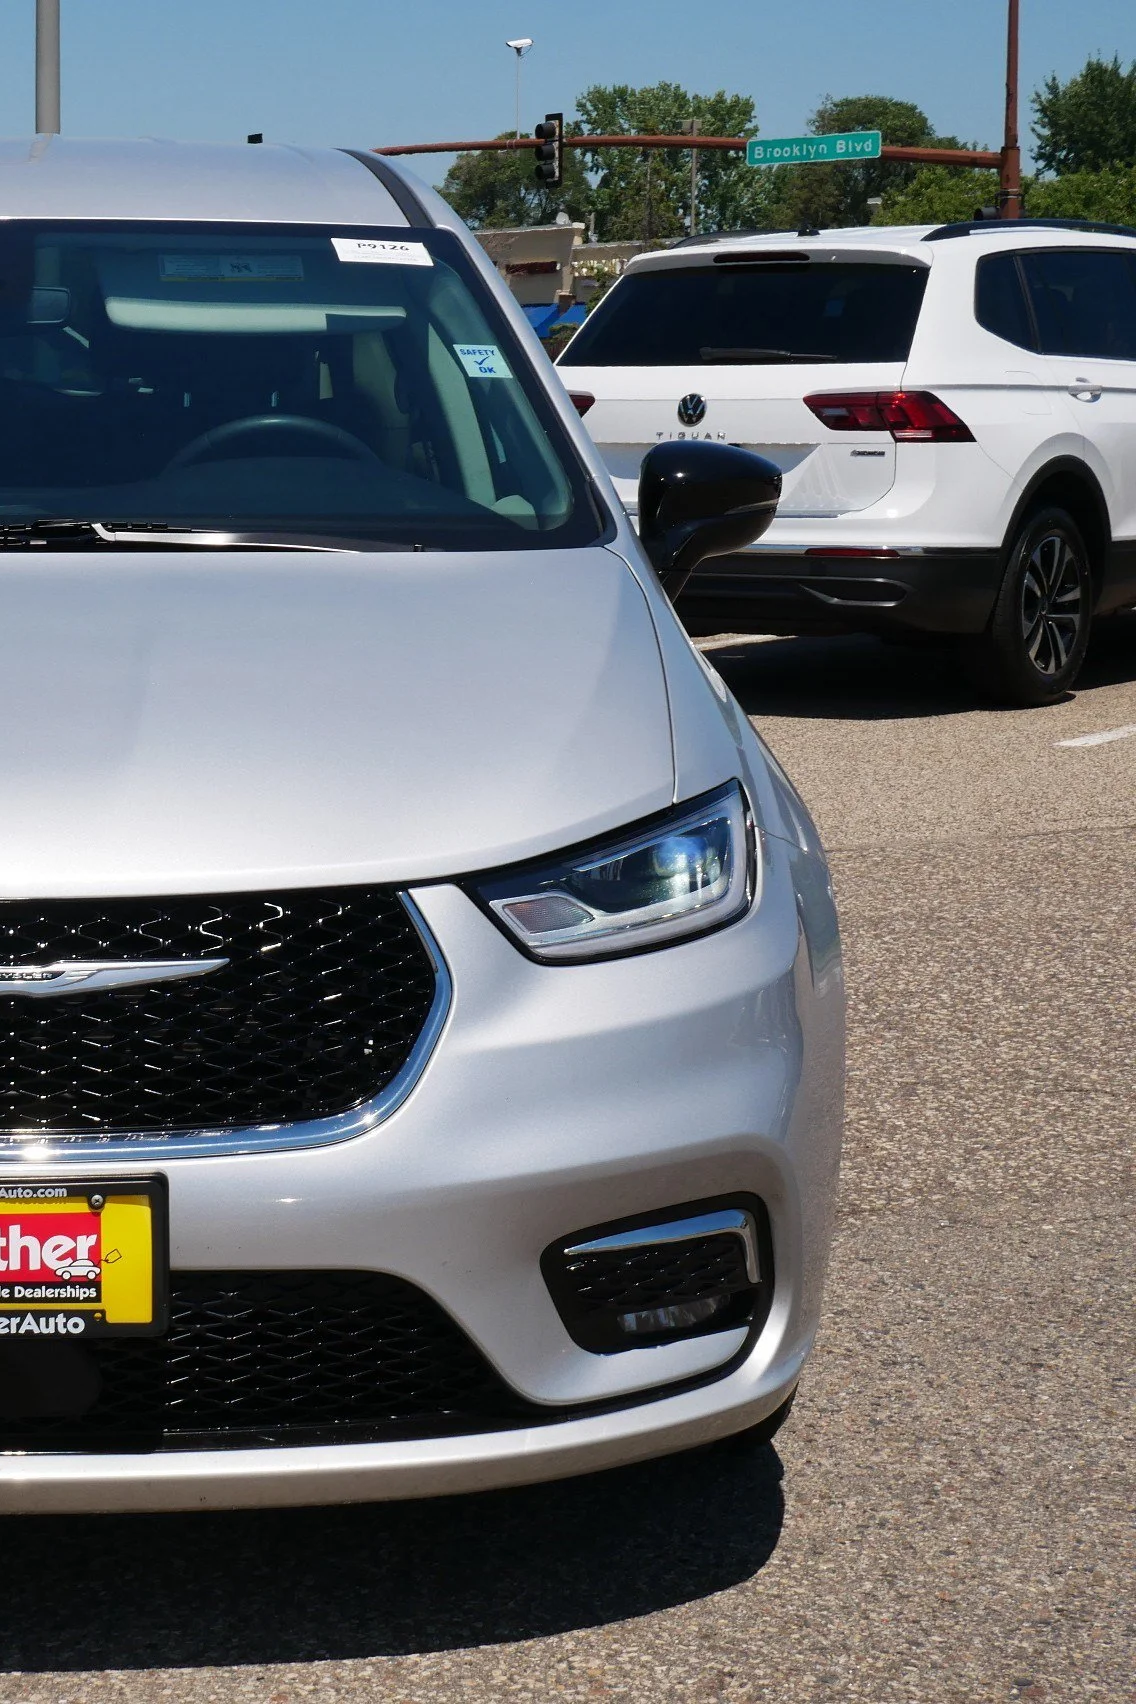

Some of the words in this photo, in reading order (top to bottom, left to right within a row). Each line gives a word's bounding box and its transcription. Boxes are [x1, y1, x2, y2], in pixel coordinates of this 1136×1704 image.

[754, 144, 827, 159] Brooklyn
[836, 139, 873, 153] Blvd
[459, 348, 495, 356] SAFETY
[479, 366, 497, 374] OK
[656, 431, 726, 440] TIGUAN
[14, 1285, 97, 1300] Dealerships
